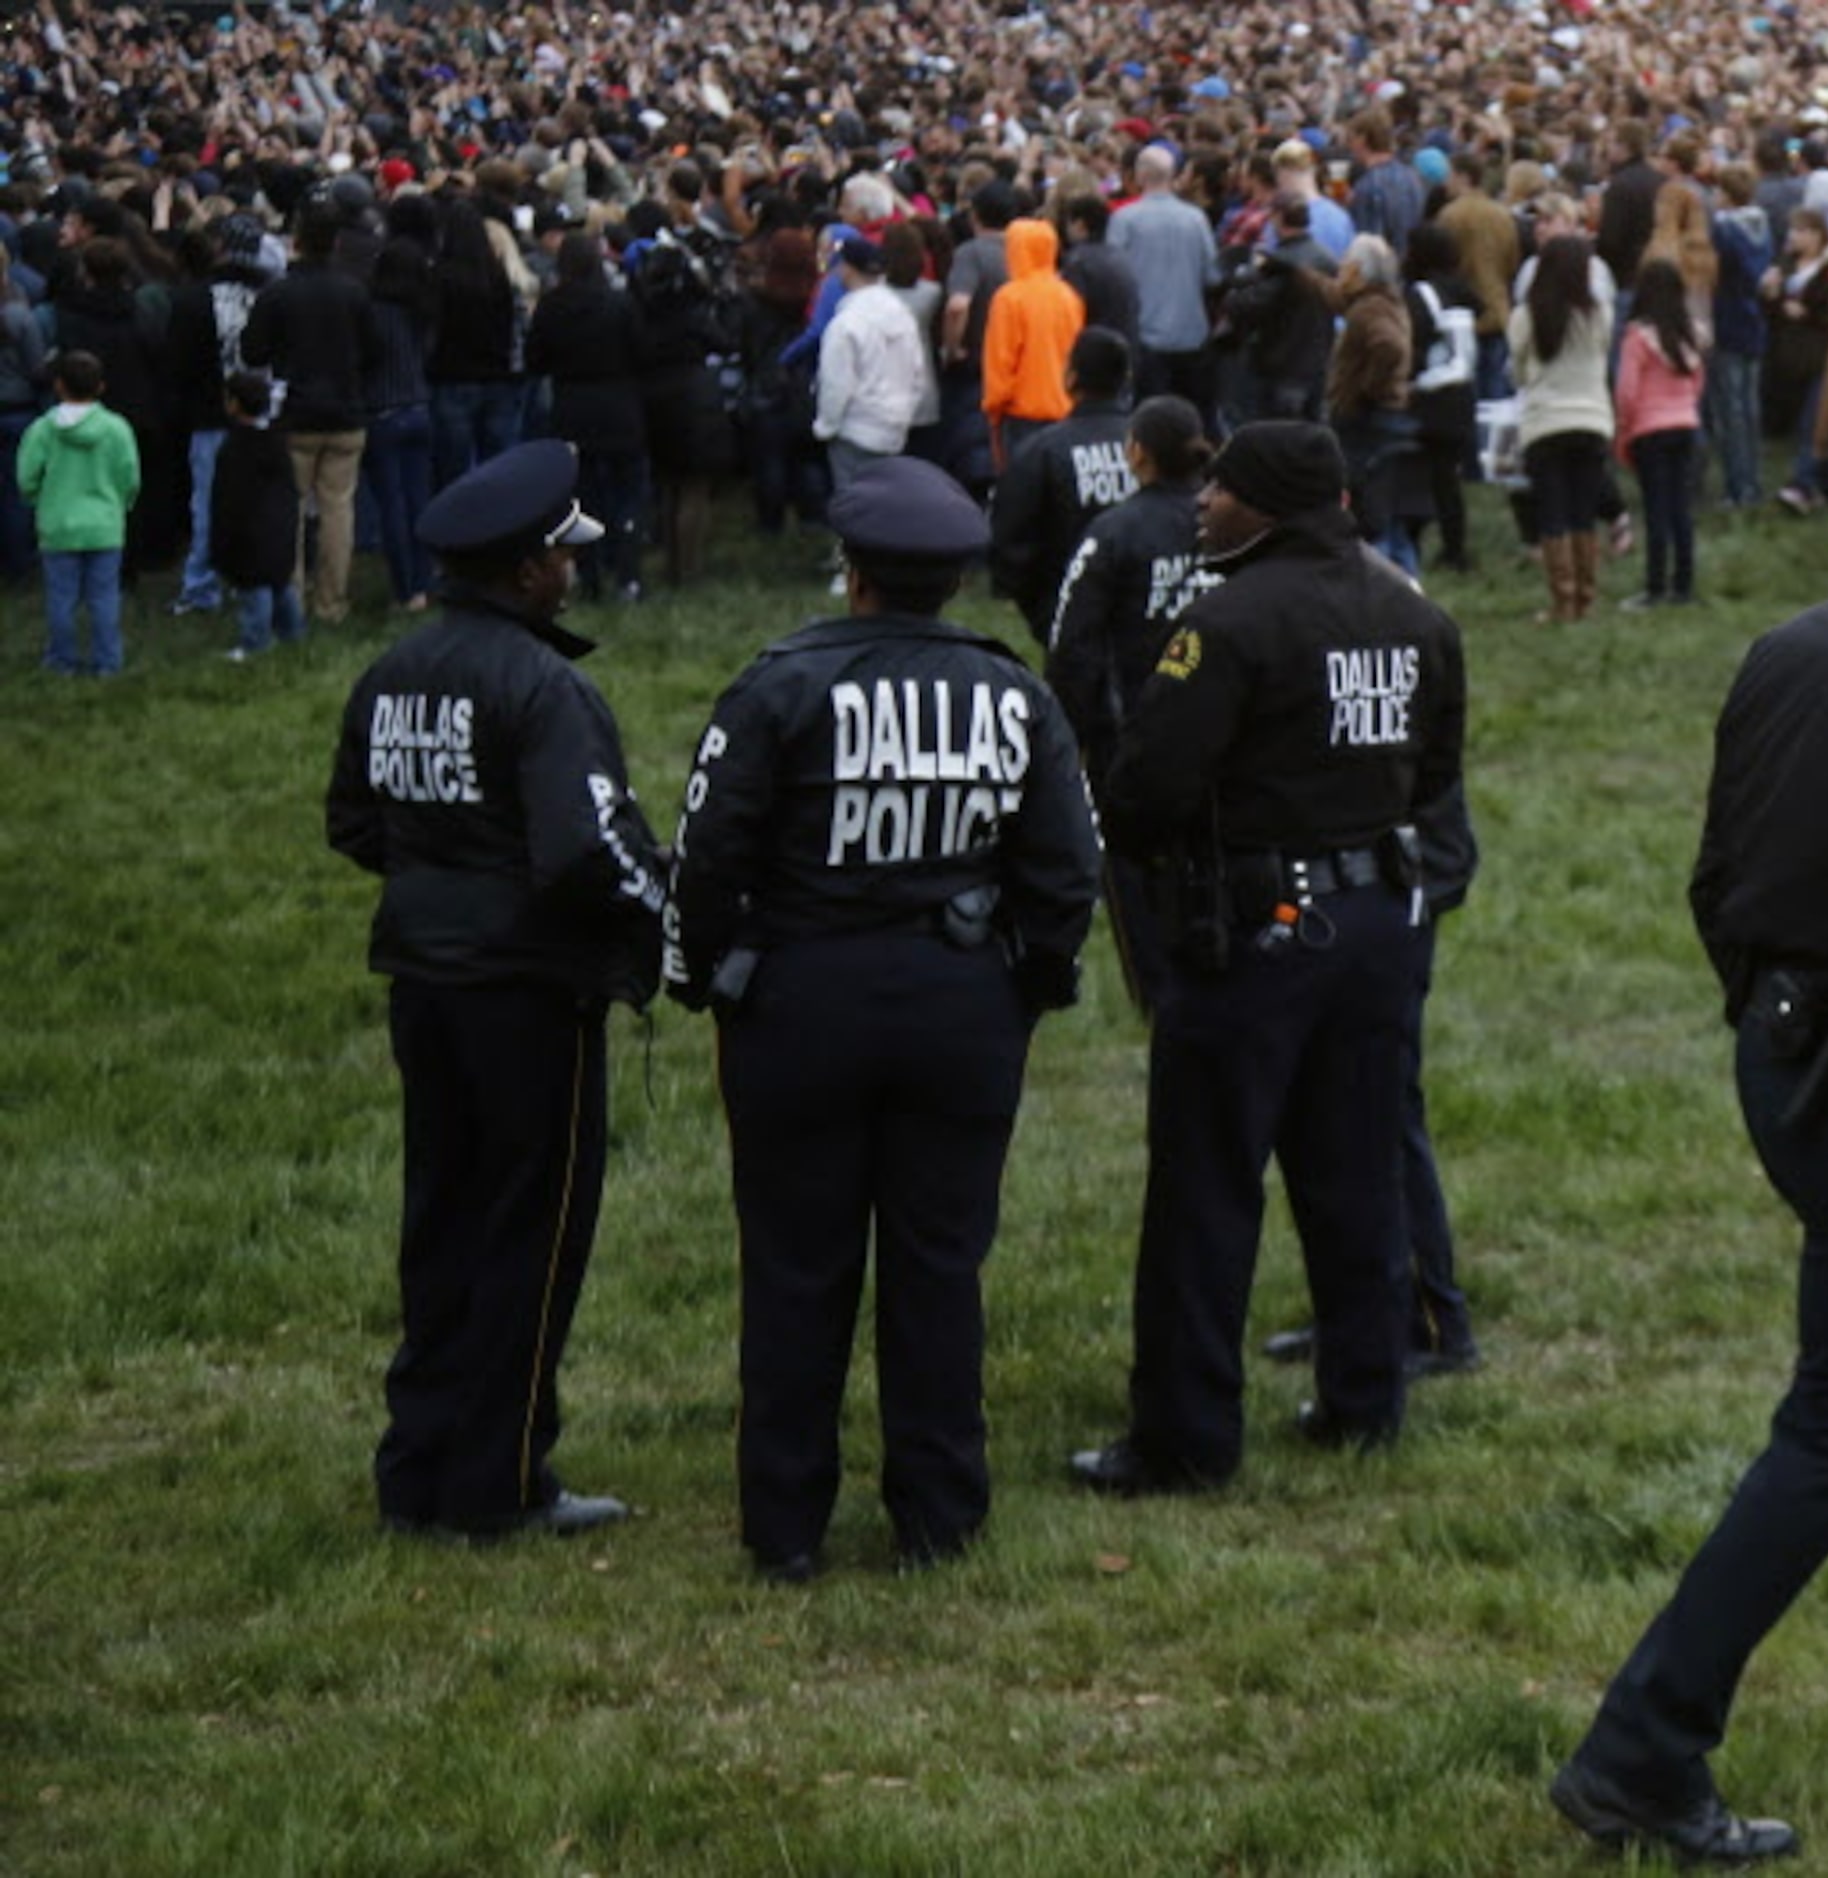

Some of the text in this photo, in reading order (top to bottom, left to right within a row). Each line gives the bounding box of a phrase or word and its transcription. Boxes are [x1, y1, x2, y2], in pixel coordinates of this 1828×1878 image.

[1072, 442, 1131, 474] DALL
[1077, 471, 1140, 506] POLI
[1326, 646, 1420, 700] DALLAS
[372, 693, 475, 751] DALLAS
[831, 677, 1031, 782] DALLAS
[1329, 695, 1409, 747] POLICE
[368, 748, 484, 804] POLICE
[826, 783, 1025, 867] POLIC
